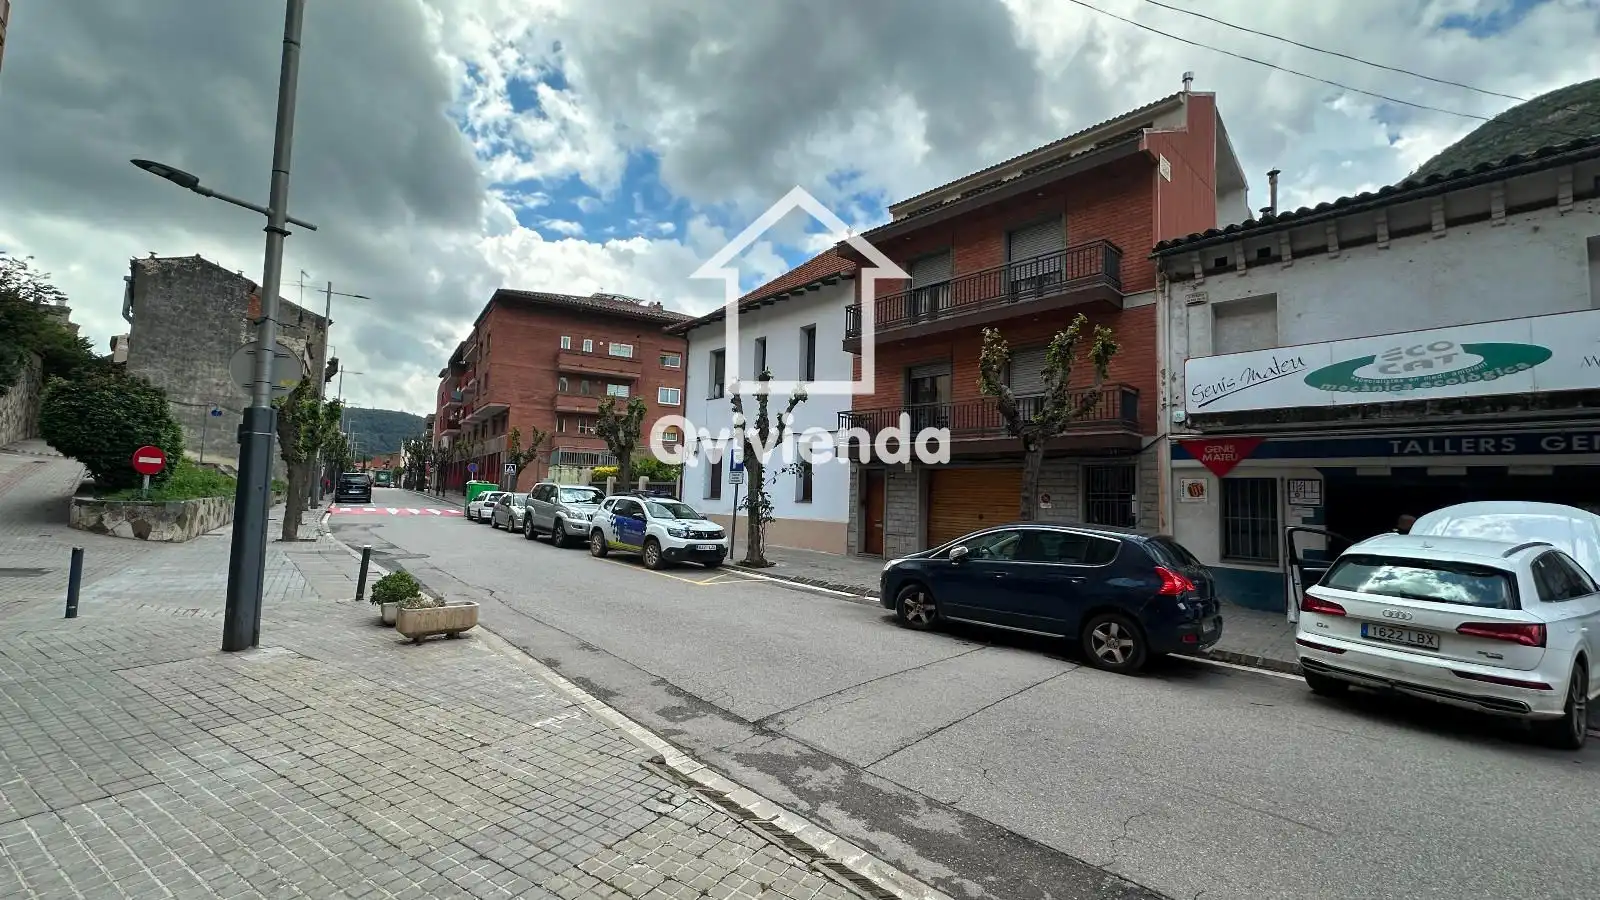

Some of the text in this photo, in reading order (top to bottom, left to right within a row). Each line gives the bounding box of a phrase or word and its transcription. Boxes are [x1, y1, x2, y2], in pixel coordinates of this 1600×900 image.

[1381, 341, 1454, 361] ECO
[1240, 356, 1306, 384] Mateu
[1379, 352, 1459, 374] CAT
[1389, 438, 1516, 454] TALLERS
[1202, 453, 1239, 462] MATEU
[1372, 626, 1434, 646] 1622 LBX
